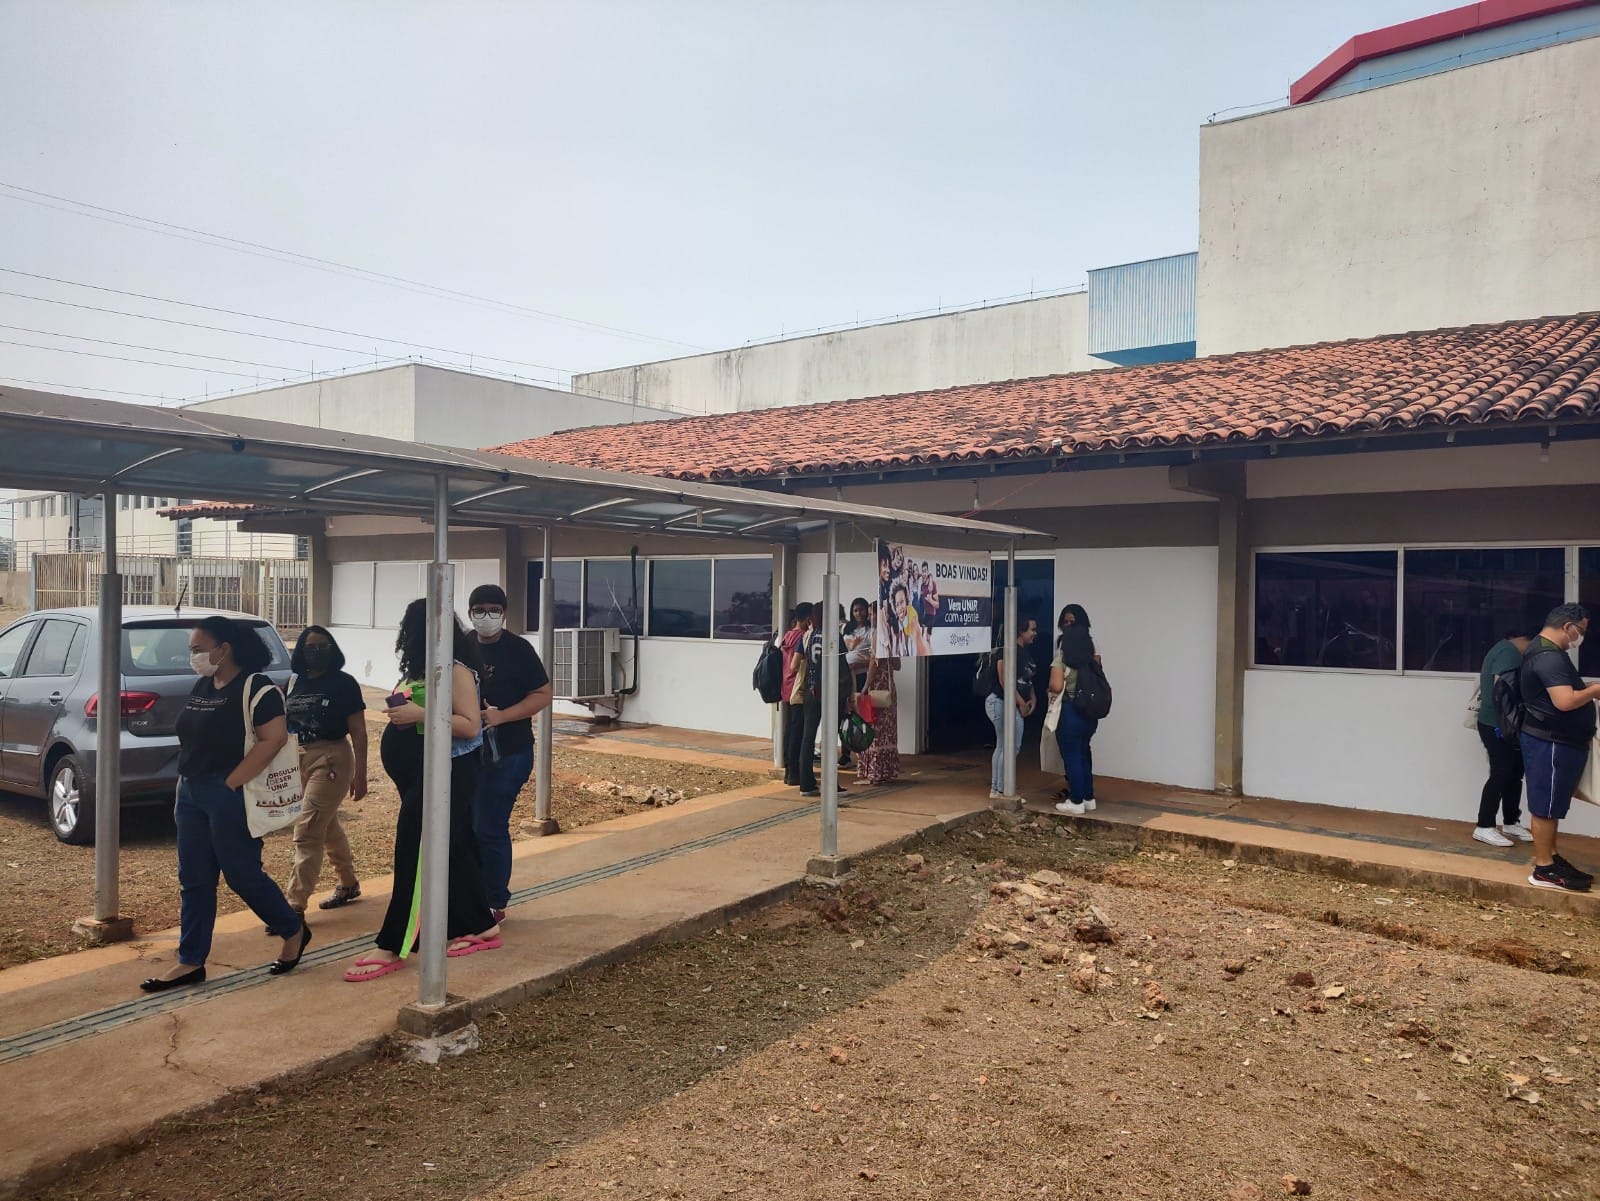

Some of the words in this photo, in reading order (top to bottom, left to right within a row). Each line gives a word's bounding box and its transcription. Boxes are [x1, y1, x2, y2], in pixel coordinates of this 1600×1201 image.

[936, 563, 957, 579] BOAS
[959, 565, 988, 581] VINDAS!
[948, 598, 961, 611] Vem
[962, 599, 978, 611] UNIR
[945, 612, 959, 623] com
[963, 611, 980, 625] gente
[271, 782, 288, 791] UNIR
